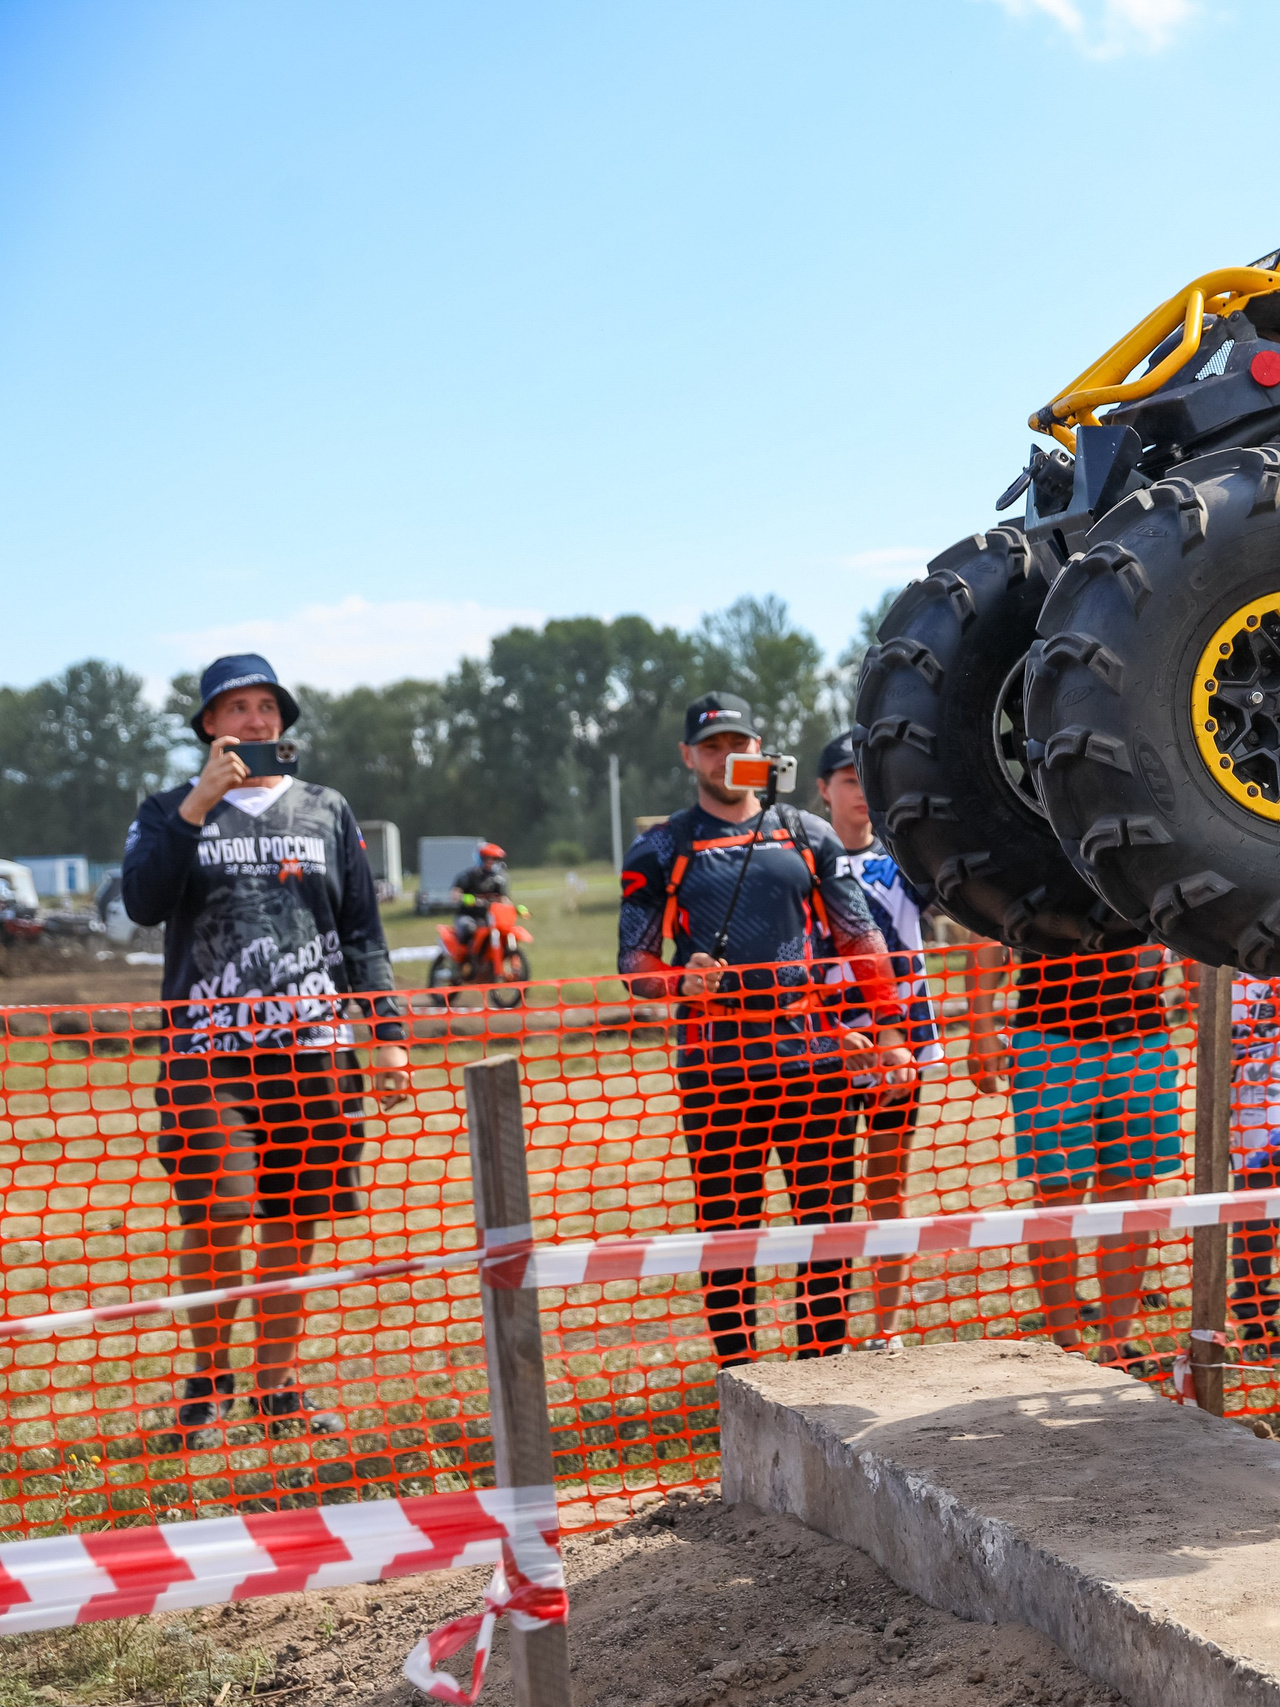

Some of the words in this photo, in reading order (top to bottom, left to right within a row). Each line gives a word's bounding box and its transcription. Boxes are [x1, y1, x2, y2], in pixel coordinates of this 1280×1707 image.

[1140, 751, 1174, 801] ITP
[198, 837, 258, 866] КУБОК
[259, 835, 326, 863] РОССИИ
